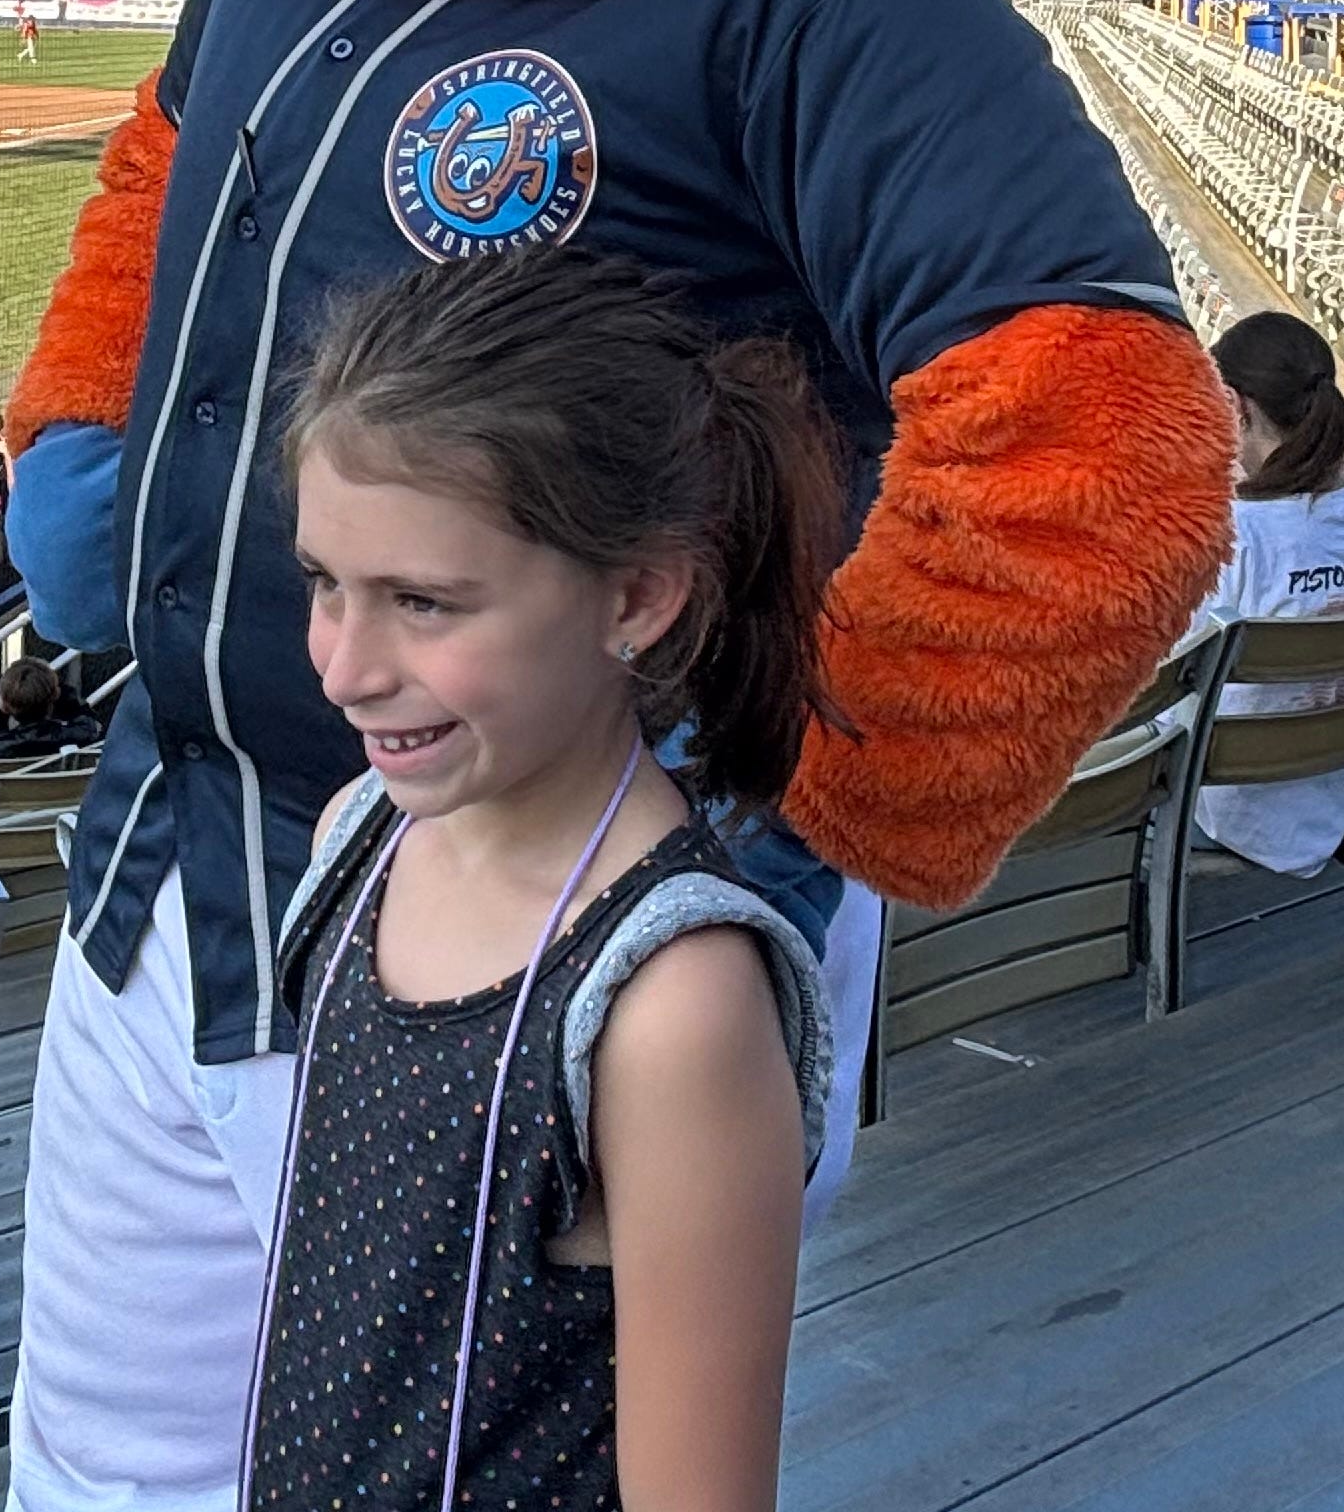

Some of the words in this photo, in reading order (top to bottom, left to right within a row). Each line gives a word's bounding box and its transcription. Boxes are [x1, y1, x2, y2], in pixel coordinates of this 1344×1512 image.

[442, 60, 582, 141] SPRINGFIELD
[397, 128, 424, 215] LUCKY
[425, 187, 577, 258] HORSESHOES
